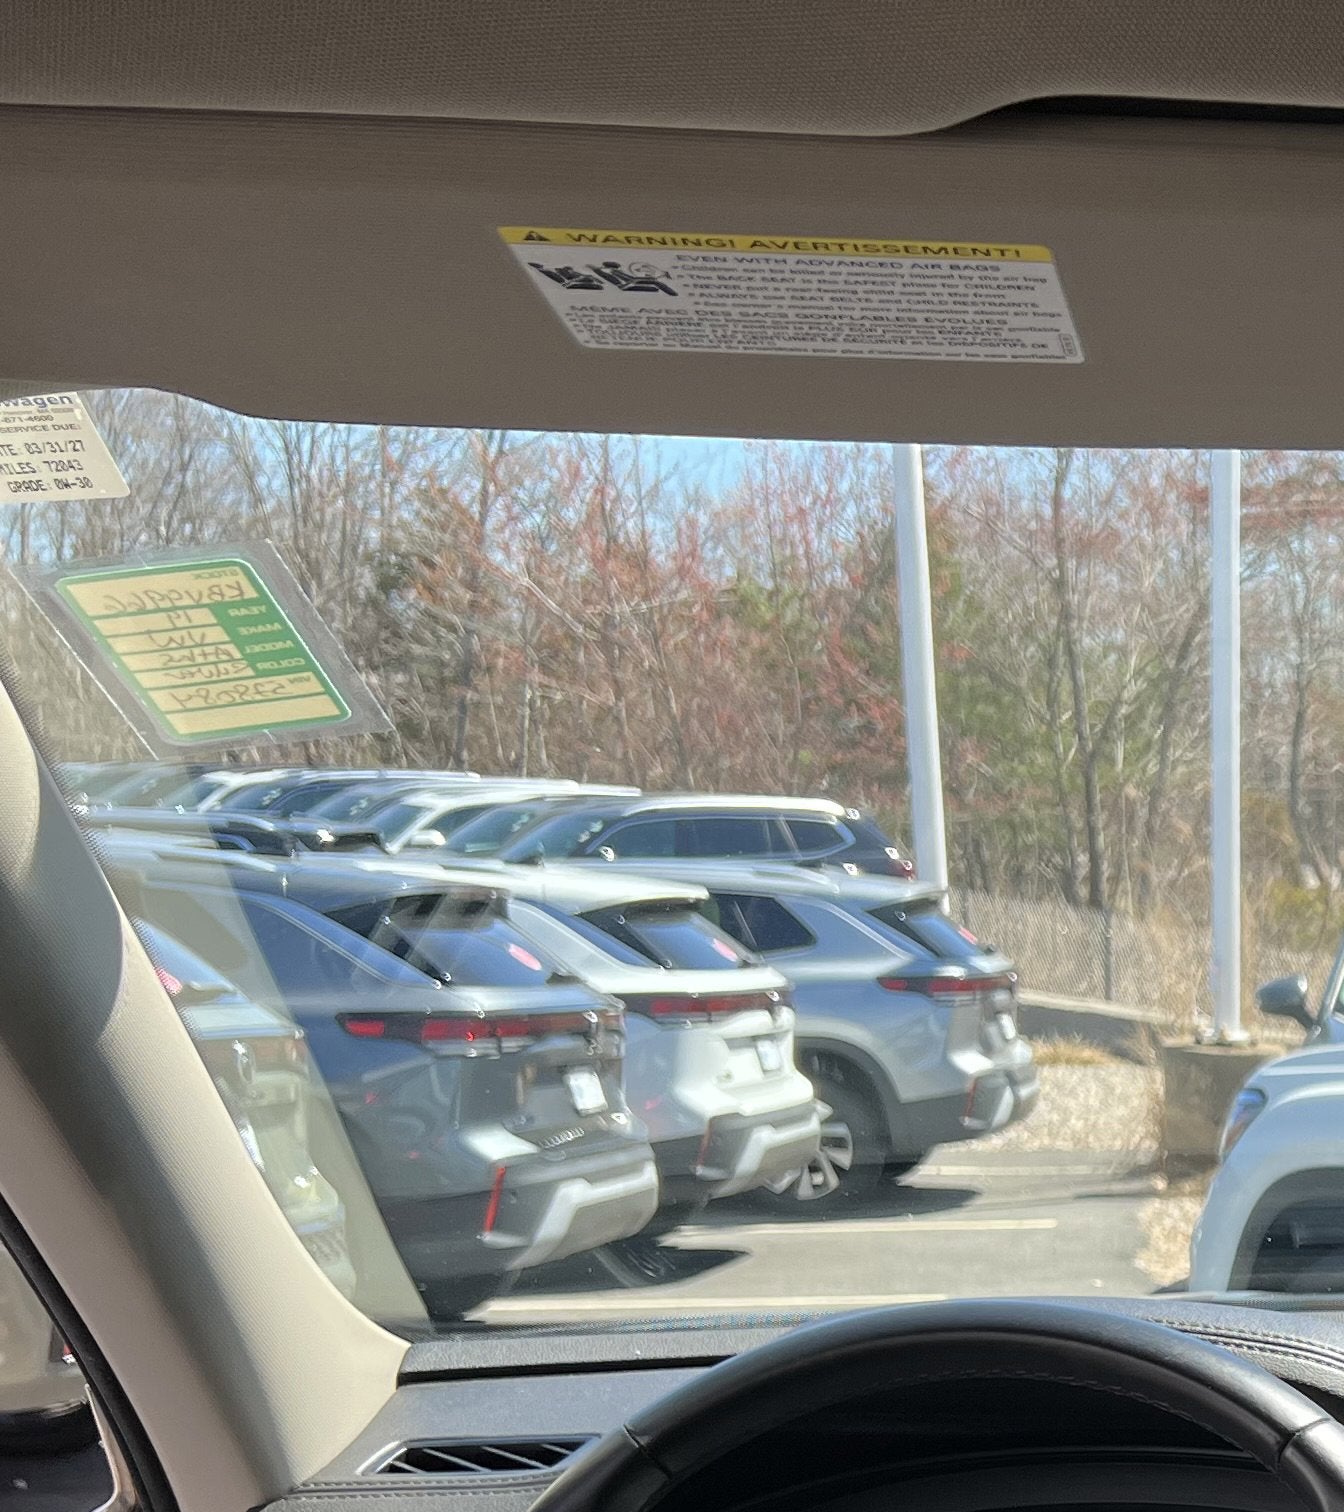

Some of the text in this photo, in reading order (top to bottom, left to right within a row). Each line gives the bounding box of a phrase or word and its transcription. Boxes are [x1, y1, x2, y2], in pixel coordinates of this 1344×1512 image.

[566, 232, 1023, 258] WARNING! AVERTISSEMENT!
[675, 254, 727, 263] EVEN
[734, 256, 788, 265] WITH
[795, 257, 904, 269] ADVANCED
[911, 262, 942, 270] AIR
[0, 395, 74, 409] wagen
[0, 424, 50, 433] SERVICE
[24, 440, 86, 455] 03/31/27
[42, 459, 84, 472] 72043
[54, 477, 94, 490] 0W-30
